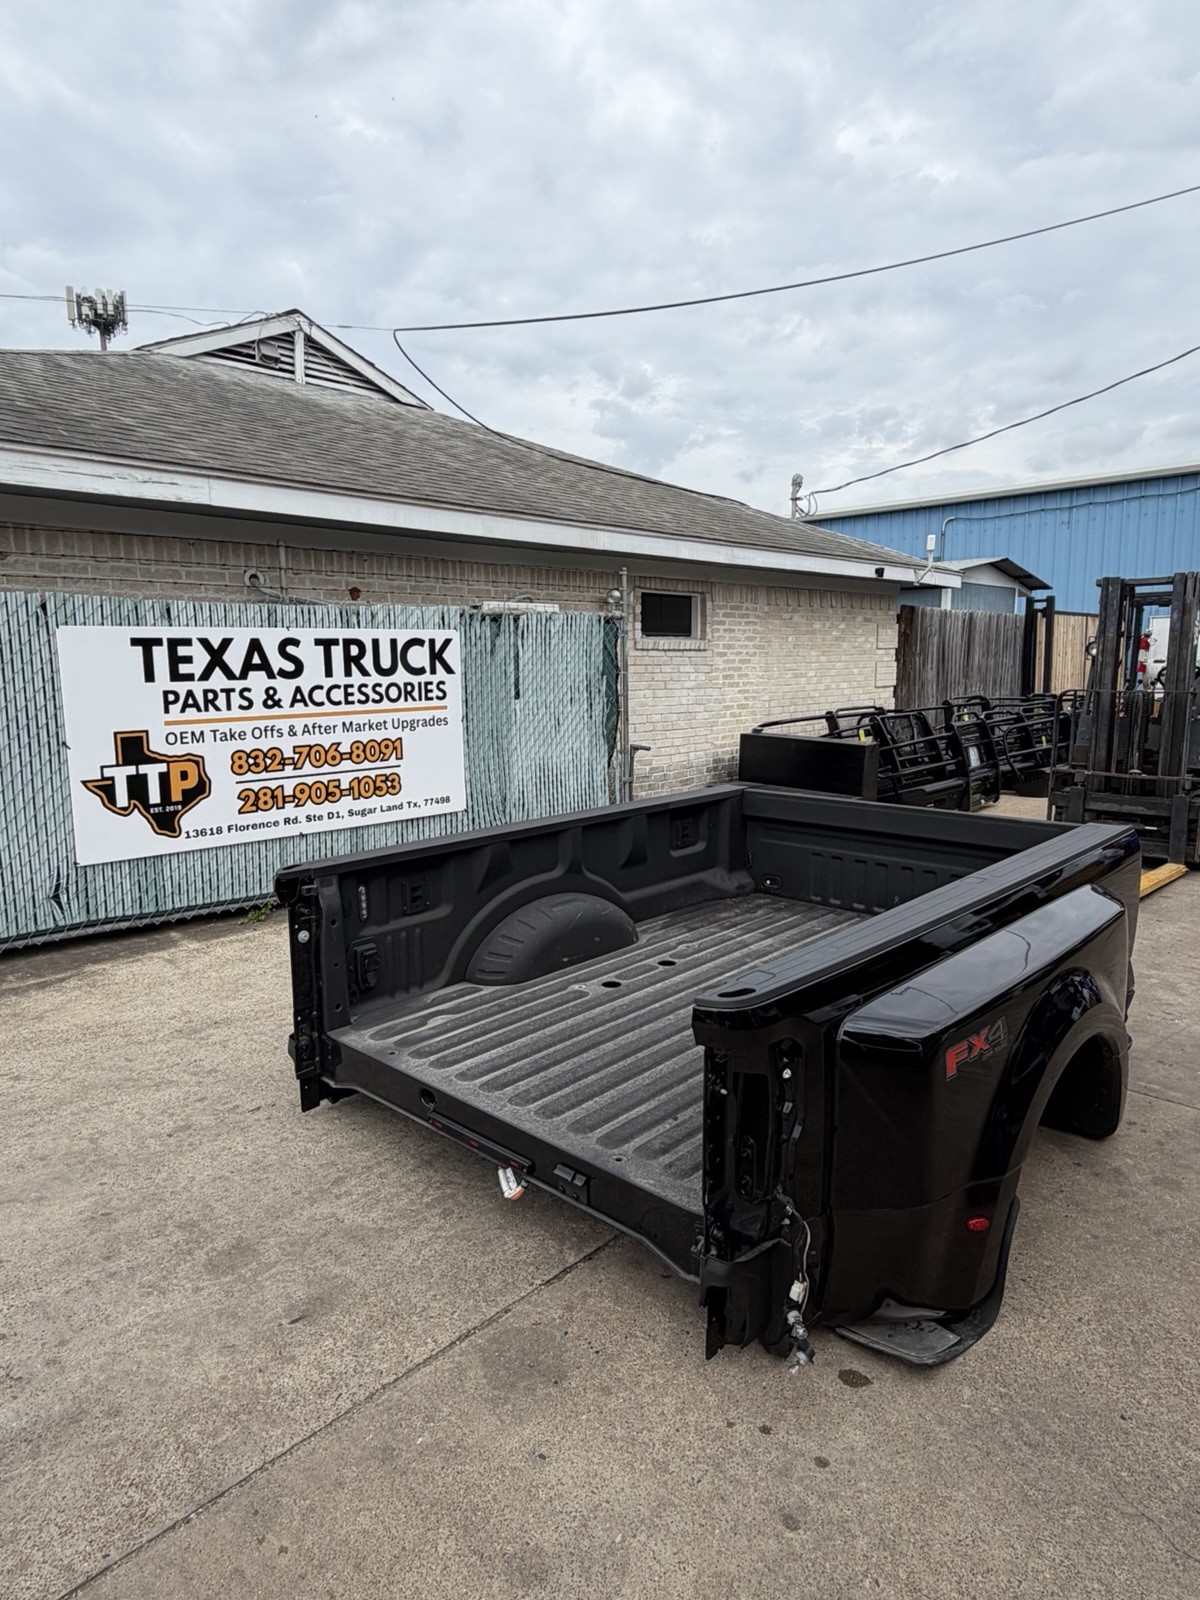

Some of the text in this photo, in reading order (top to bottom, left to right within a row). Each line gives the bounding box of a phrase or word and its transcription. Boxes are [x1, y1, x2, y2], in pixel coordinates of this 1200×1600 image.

[130, 637, 455, 683] TEXAS TRUCK
[162, 681, 447, 714] PARTS & ACCESSORIES
[165, 715, 449, 746] OEM Take Offs & After Market Upgrades
[230, 736, 404, 776] 832-706-8091
[102, 761, 199, 808] TTP
[237, 772, 402, 815] 281-905-1053
[184, 795, 451, 839] 13618 Florence Rd. Ste D1, Sugar Land Tx, 77498
[945, 1016, 1008, 1081] FX4
